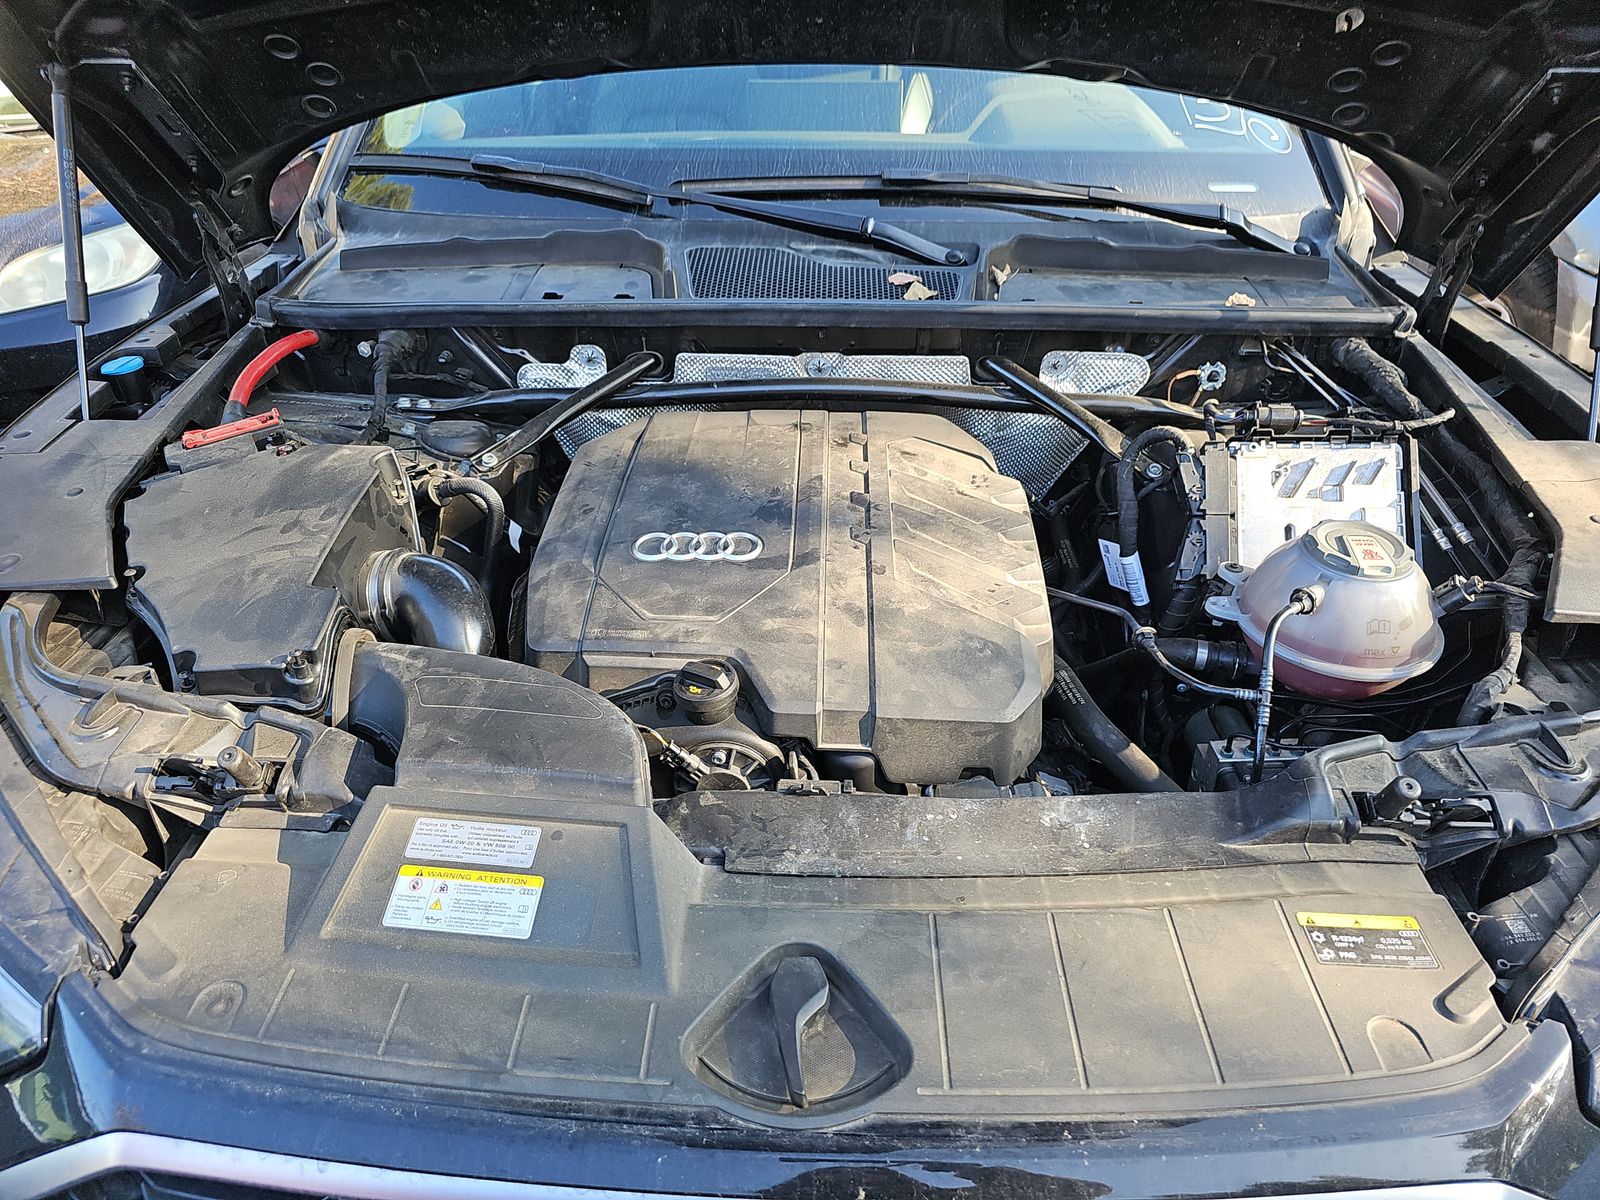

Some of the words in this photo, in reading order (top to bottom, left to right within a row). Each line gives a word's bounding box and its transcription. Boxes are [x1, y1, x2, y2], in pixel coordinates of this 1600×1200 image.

[1364, 648, 1386, 657] max
[426, 870, 472, 880] WARNING
[476, 875, 528, 885] ATTENTION
